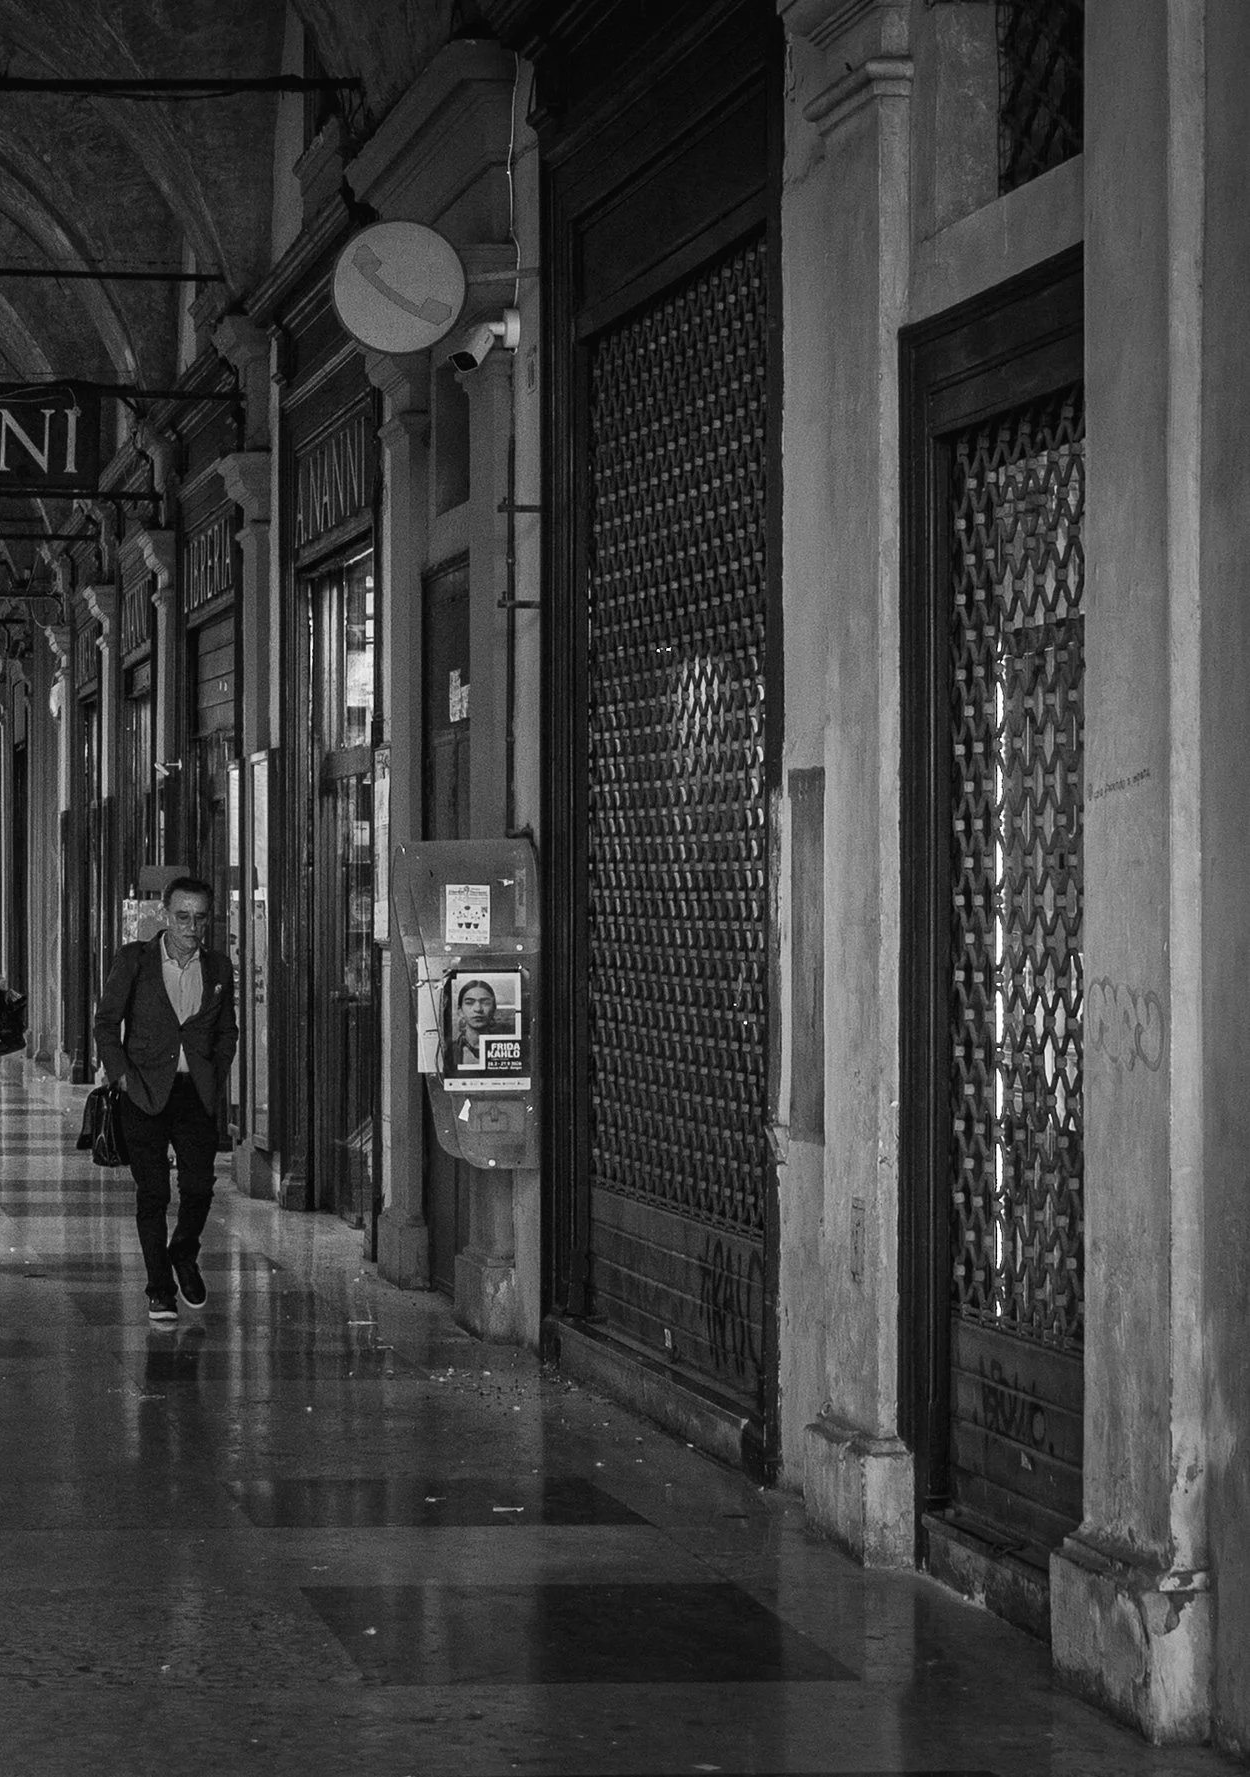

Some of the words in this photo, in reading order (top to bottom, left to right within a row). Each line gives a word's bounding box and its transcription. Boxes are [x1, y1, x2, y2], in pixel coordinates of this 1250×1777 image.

[183, 517, 233, 614] LIBRERIA
[491, 1042, 521, 1051] FRIDA
[487, 1050, 521, 1058] KAHLO
